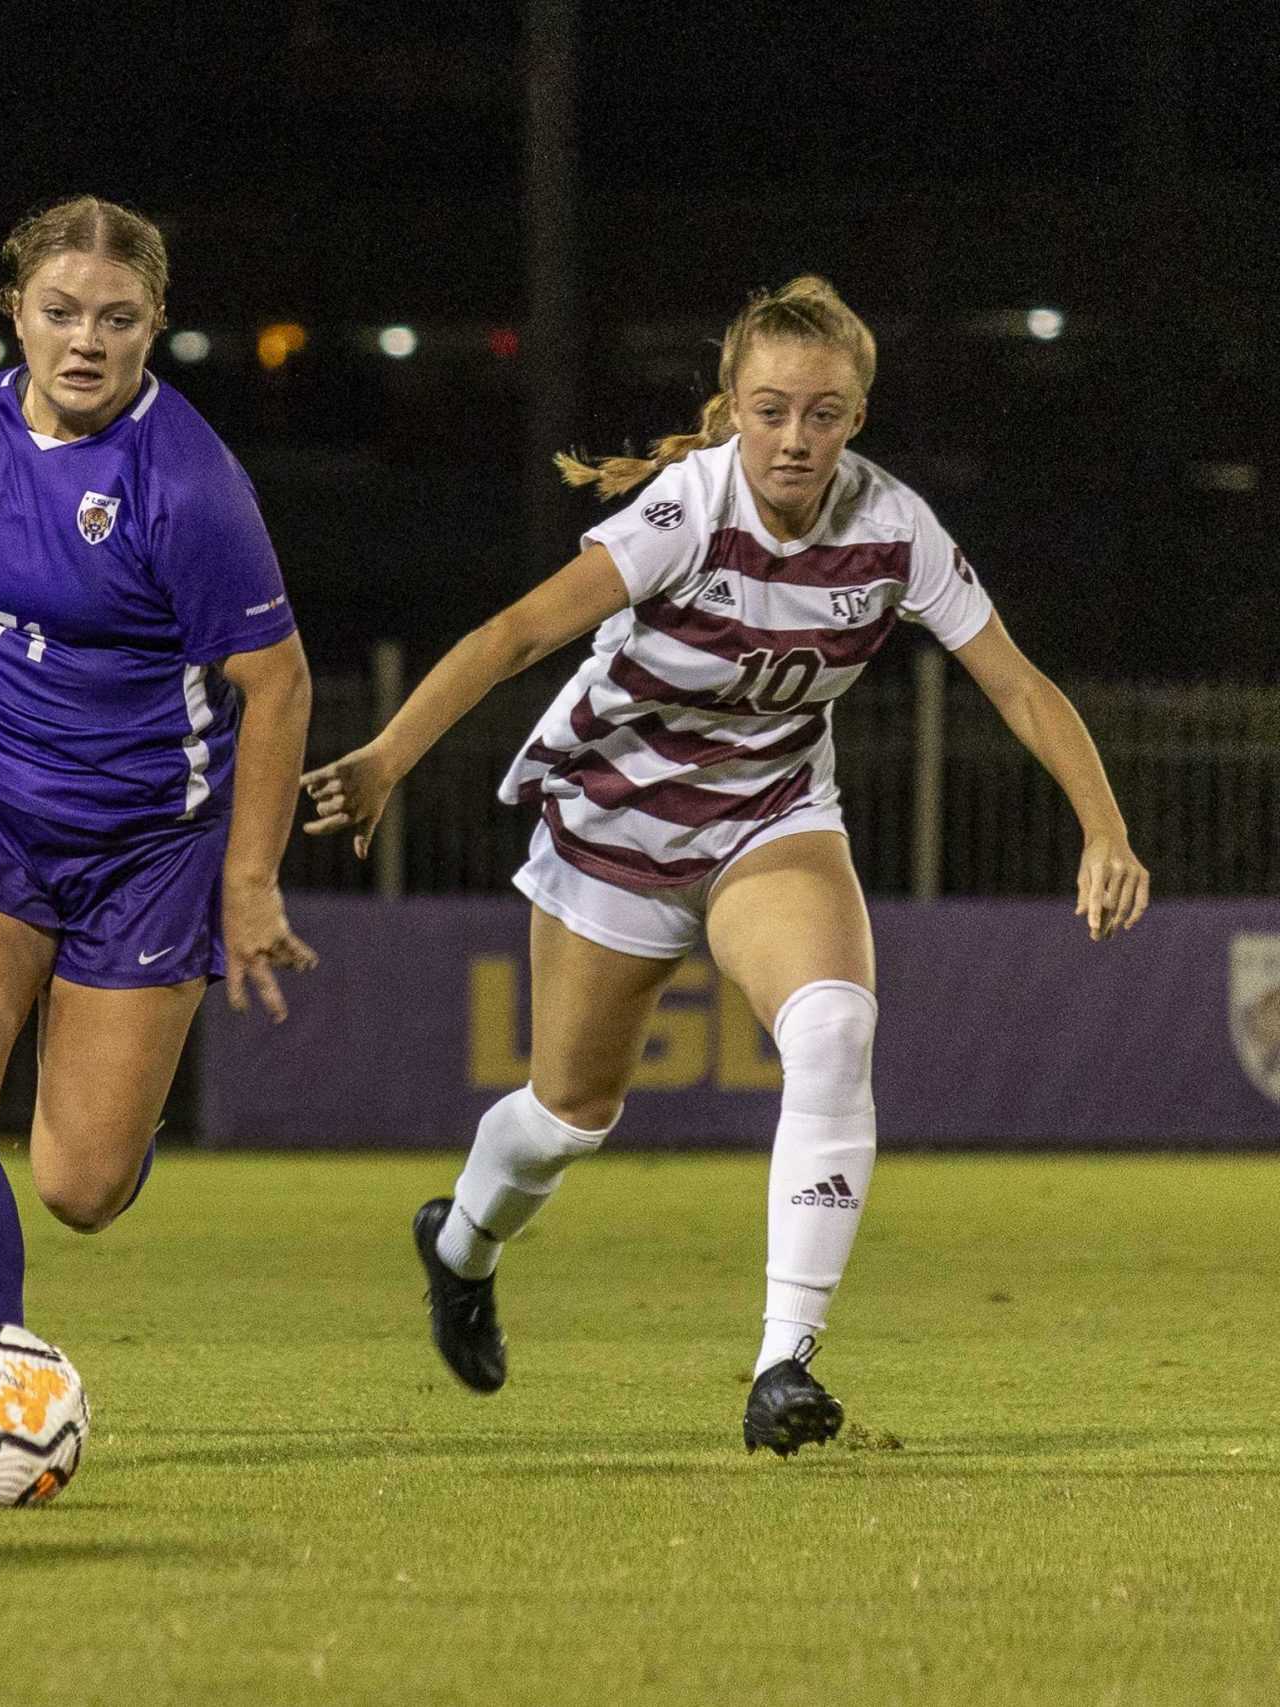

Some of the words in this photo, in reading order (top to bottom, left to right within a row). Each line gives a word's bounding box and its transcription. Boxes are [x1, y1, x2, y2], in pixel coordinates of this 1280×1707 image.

[644, 502, 683, 528] SEC
[712, 646, 827, 715] 10
[791, 1191, 860, 1209] adidas
